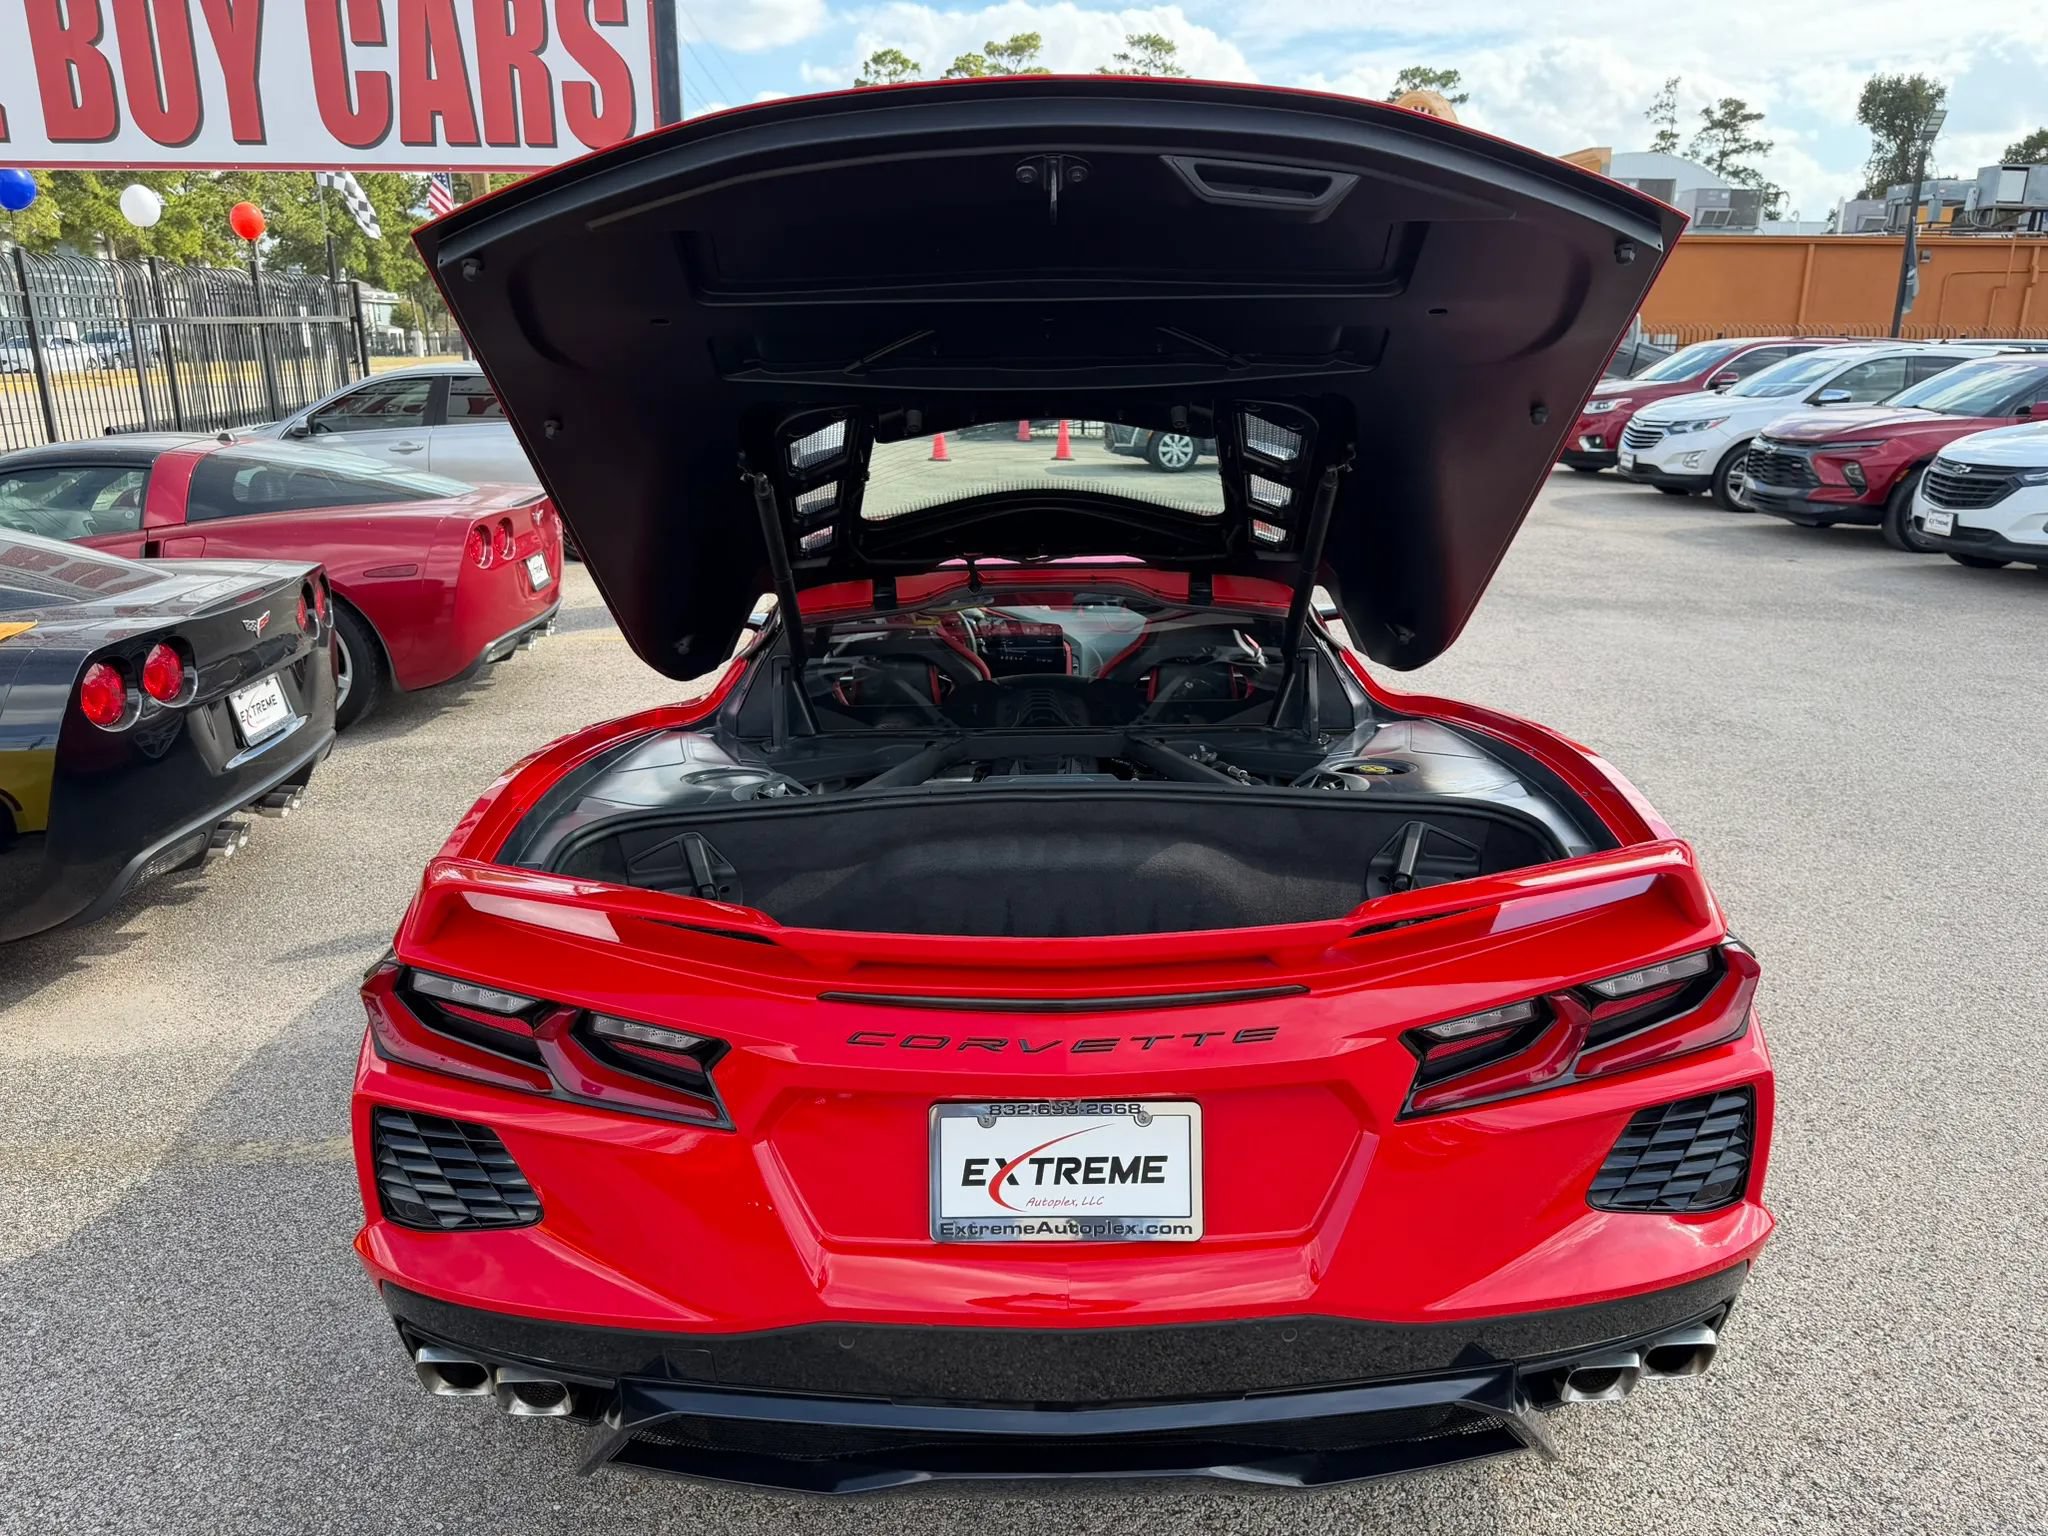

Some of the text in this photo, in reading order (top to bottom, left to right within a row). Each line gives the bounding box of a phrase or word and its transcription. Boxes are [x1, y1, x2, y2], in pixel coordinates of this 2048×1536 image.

[25, 0, 636, 149] BUY CARS
[846, 1026, 1280, 1054] CORVETTE
[961, 1155, 1168, 1187] EXTREME
[1025, 1196, 1104, 1209] Autoplex, LLC
[940, 1221, 1193, 1237] ExtremeAutoplex.com
